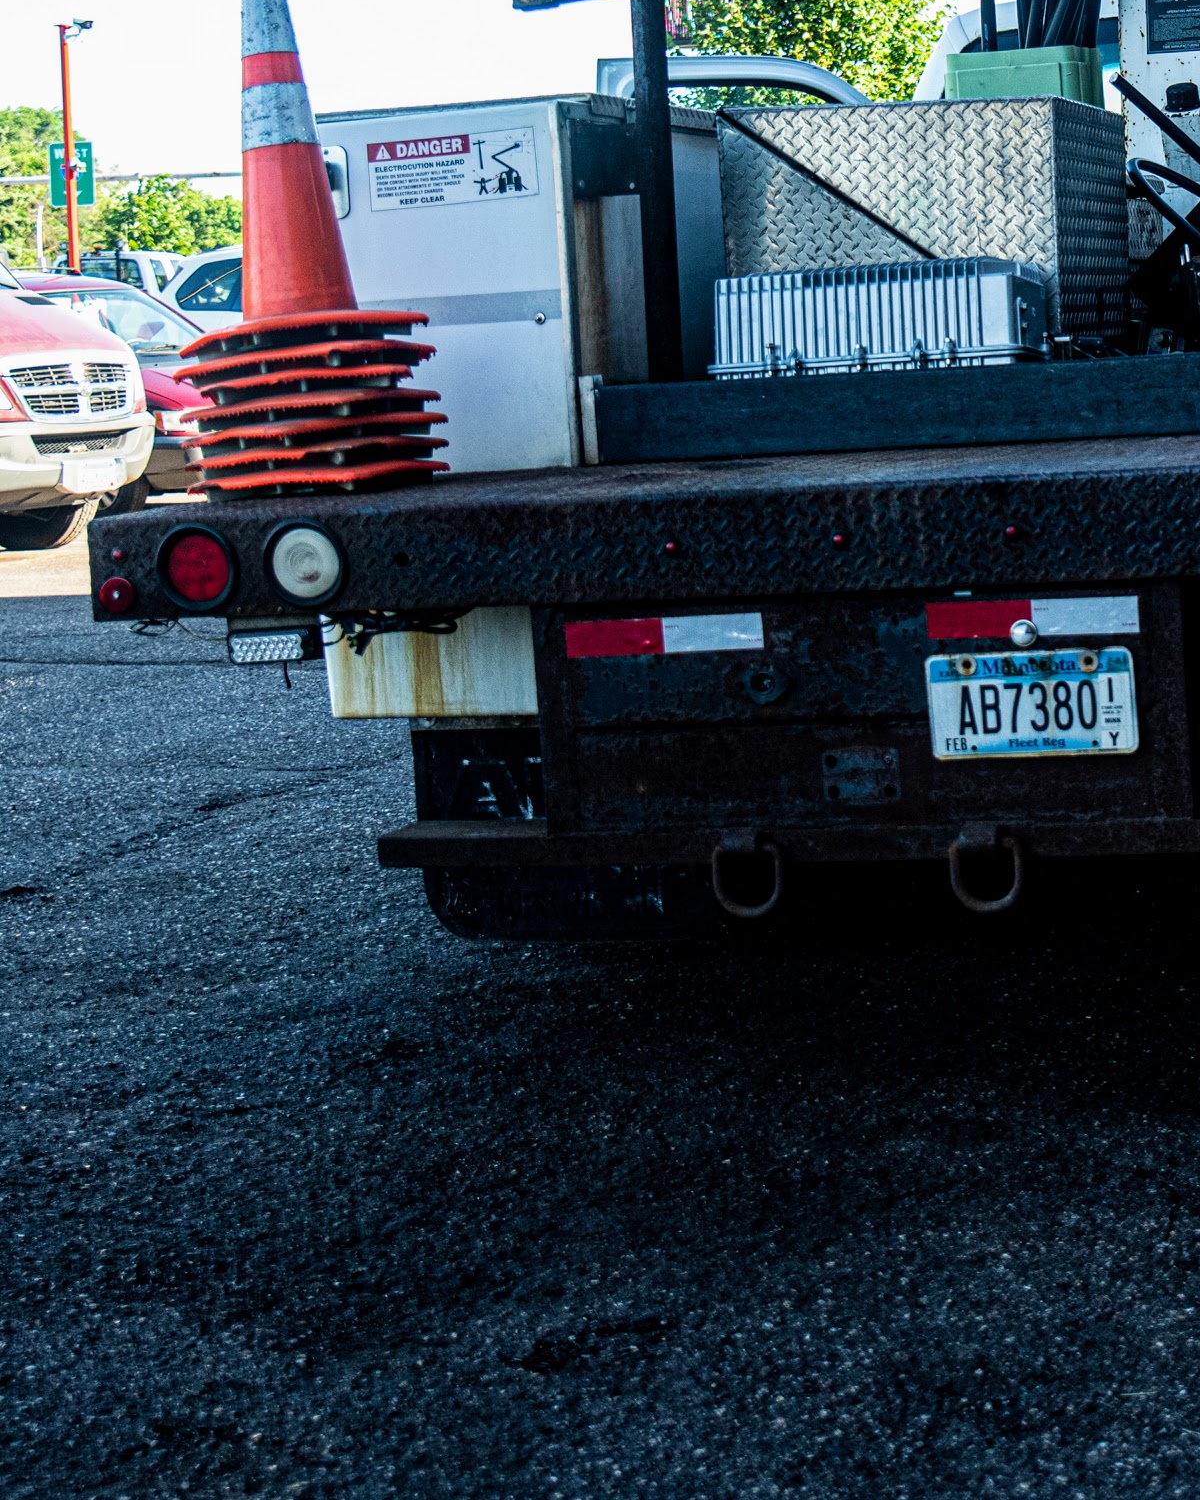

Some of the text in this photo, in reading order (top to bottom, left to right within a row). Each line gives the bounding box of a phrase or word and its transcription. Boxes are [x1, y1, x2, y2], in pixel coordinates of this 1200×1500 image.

[54, 148, 88, 160] WST
[395, 138, 464, 158] DANGER
[375, 158, 465, 173] ELECTROCUTION HAZARD
[399, 195, 445, 206] KEEP CLEAR
[959, 679, 1098, 735] AB7380
[945, 737, 1067, 751] FEB Fleet Reg
[1108, 731, 1120, 746] Y
